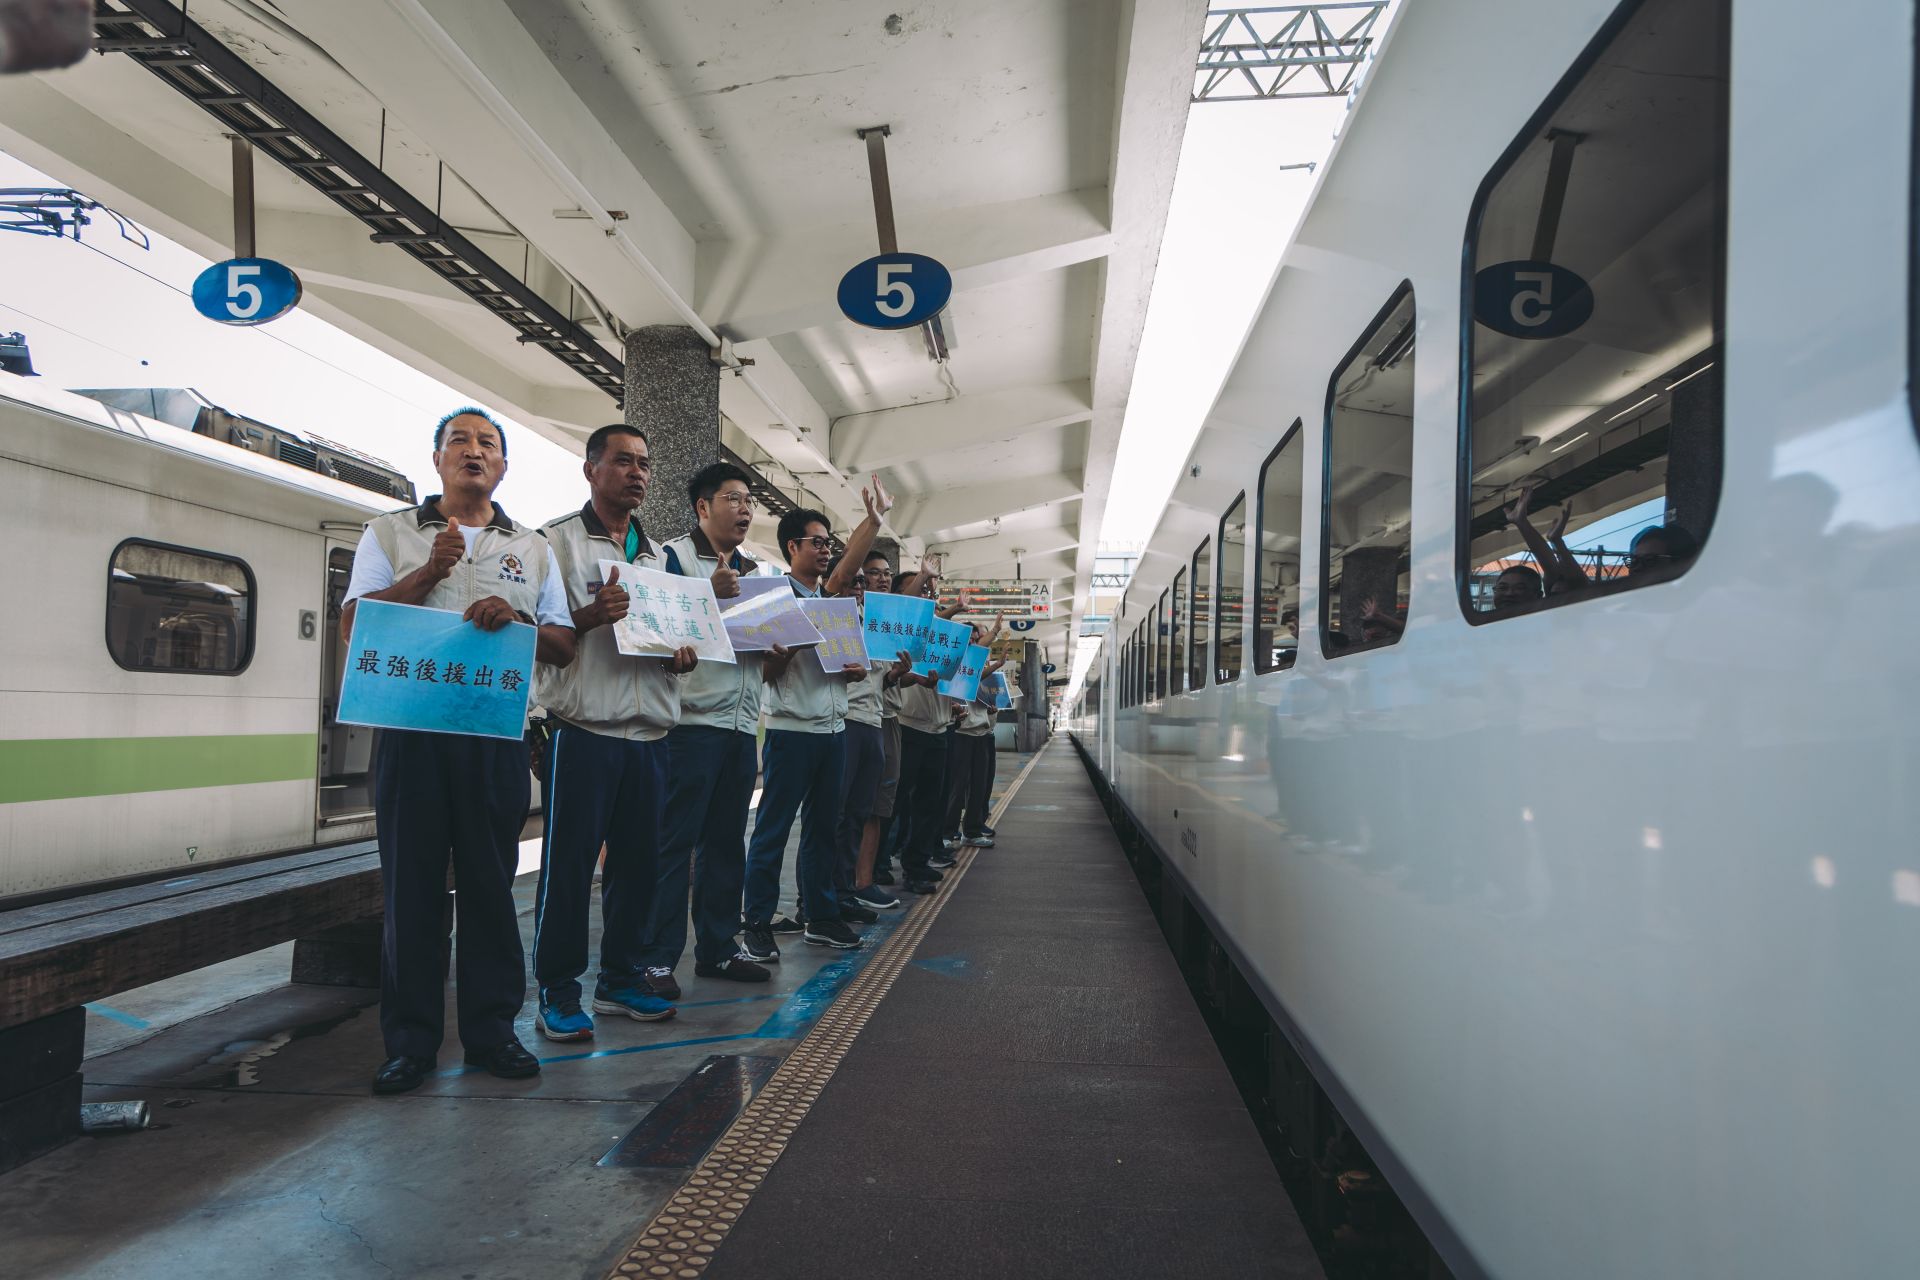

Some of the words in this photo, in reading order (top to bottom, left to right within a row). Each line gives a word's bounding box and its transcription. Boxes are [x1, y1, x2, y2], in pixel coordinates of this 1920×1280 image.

[226, 265, 262, 317] 5
[875, 263, 915, 318] 5
[1032, 584, 1049, 595] 2A
[301, 612, 315, 638] 6
[356, 650, 524, 691] 最強後援出發
[1045, 664, 1052, 673] 7
